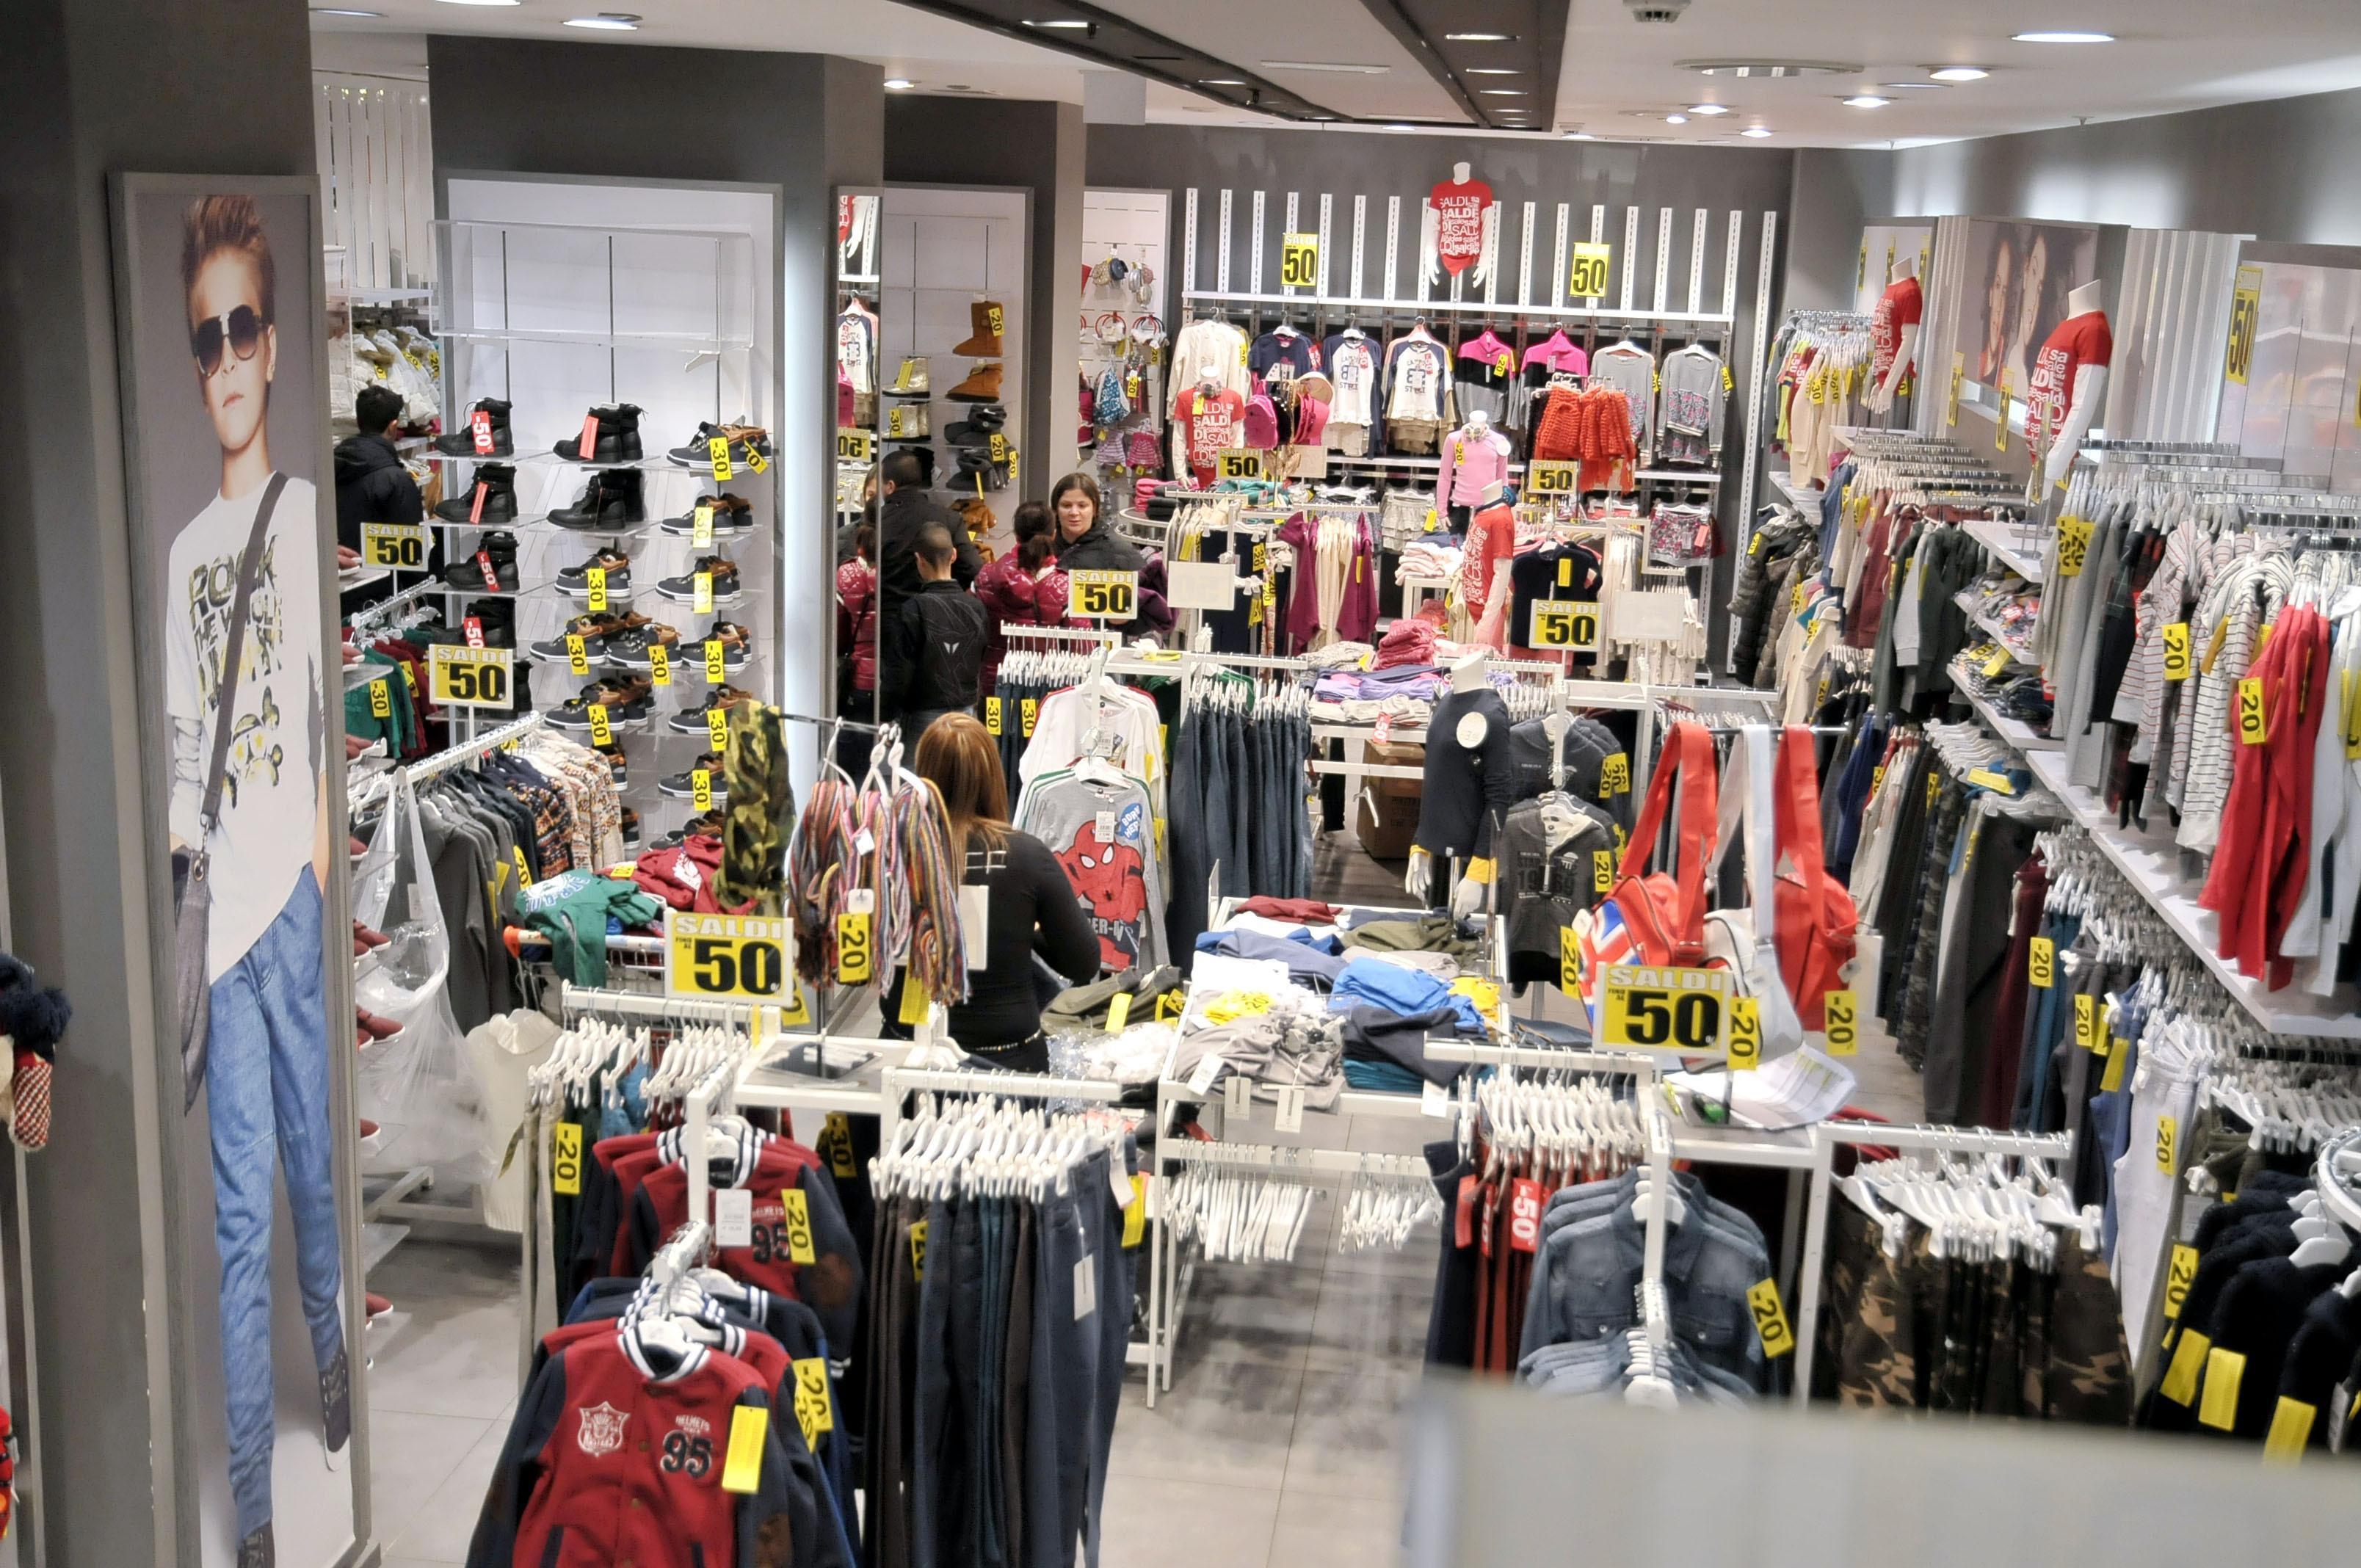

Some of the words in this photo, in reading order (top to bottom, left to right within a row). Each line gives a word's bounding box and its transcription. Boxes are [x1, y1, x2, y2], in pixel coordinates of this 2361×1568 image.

[1076, 572, 1133, 583] SALDI
[1538, 603, 1597, 614] SALDI
[438, 648, 507, 664] SALDI
[675, 916, 783, 940] SALDI
[1609, 967, 1722, 991] SALDI
[660, 1429, 712, 1479] 95
